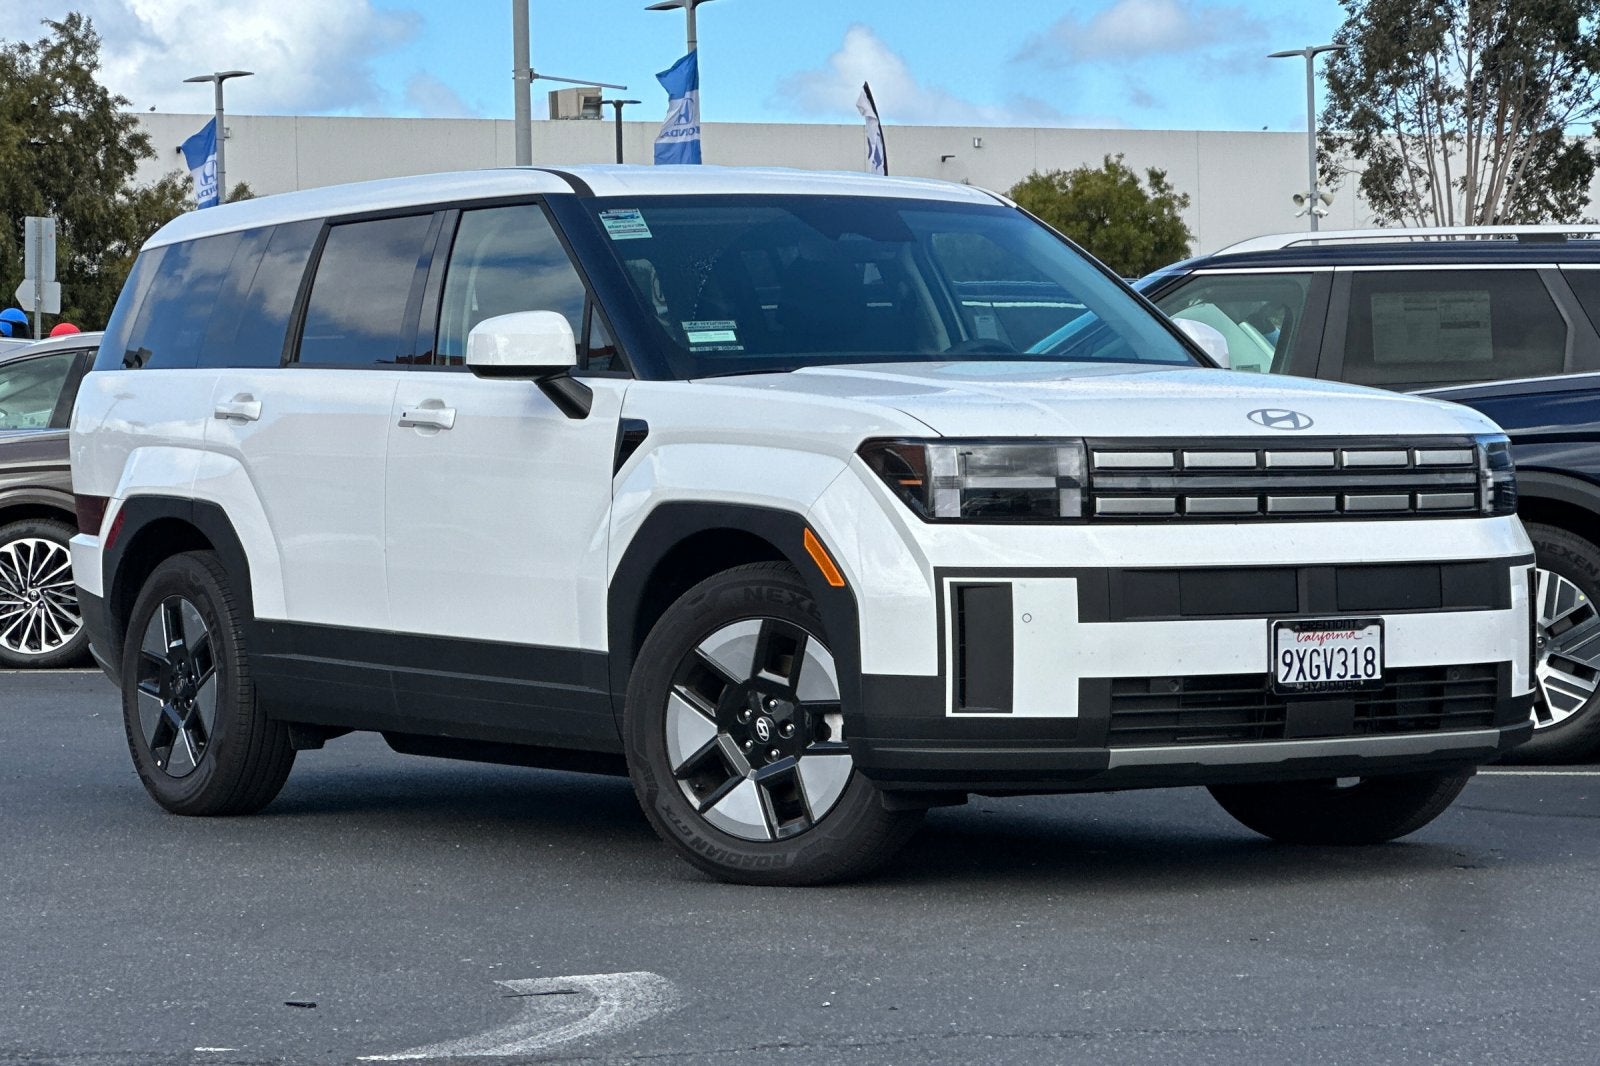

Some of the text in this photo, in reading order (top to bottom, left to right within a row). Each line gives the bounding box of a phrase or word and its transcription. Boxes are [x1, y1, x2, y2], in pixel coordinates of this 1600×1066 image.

[1296, 631, 1362, 646] California
[1281, 646, 1376, 682] 9XGV318
[689, 836, 788, 866] ROADIAN
